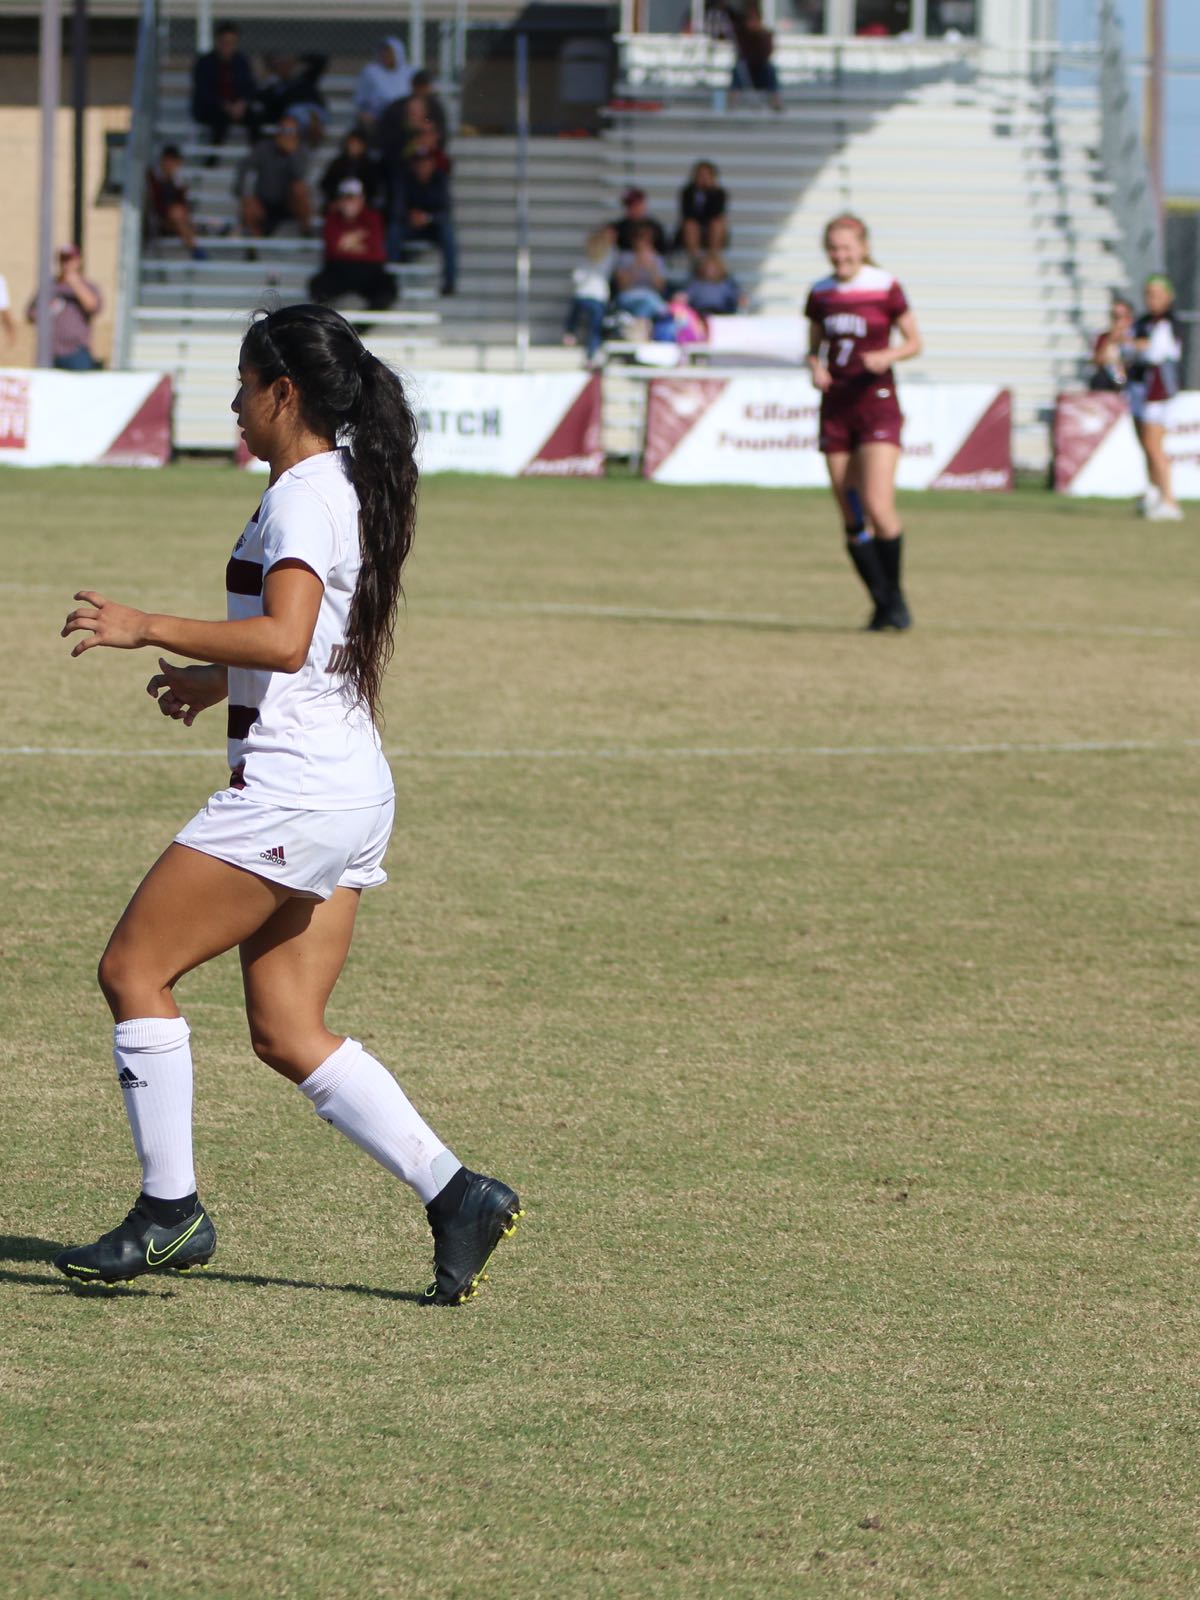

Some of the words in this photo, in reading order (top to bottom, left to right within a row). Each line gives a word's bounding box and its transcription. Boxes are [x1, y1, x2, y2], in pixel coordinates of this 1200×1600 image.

[836, 338, 855, 367] 7
[417, 408, 502, 437] ATCH
[259, 852, 287, 866] adidas
